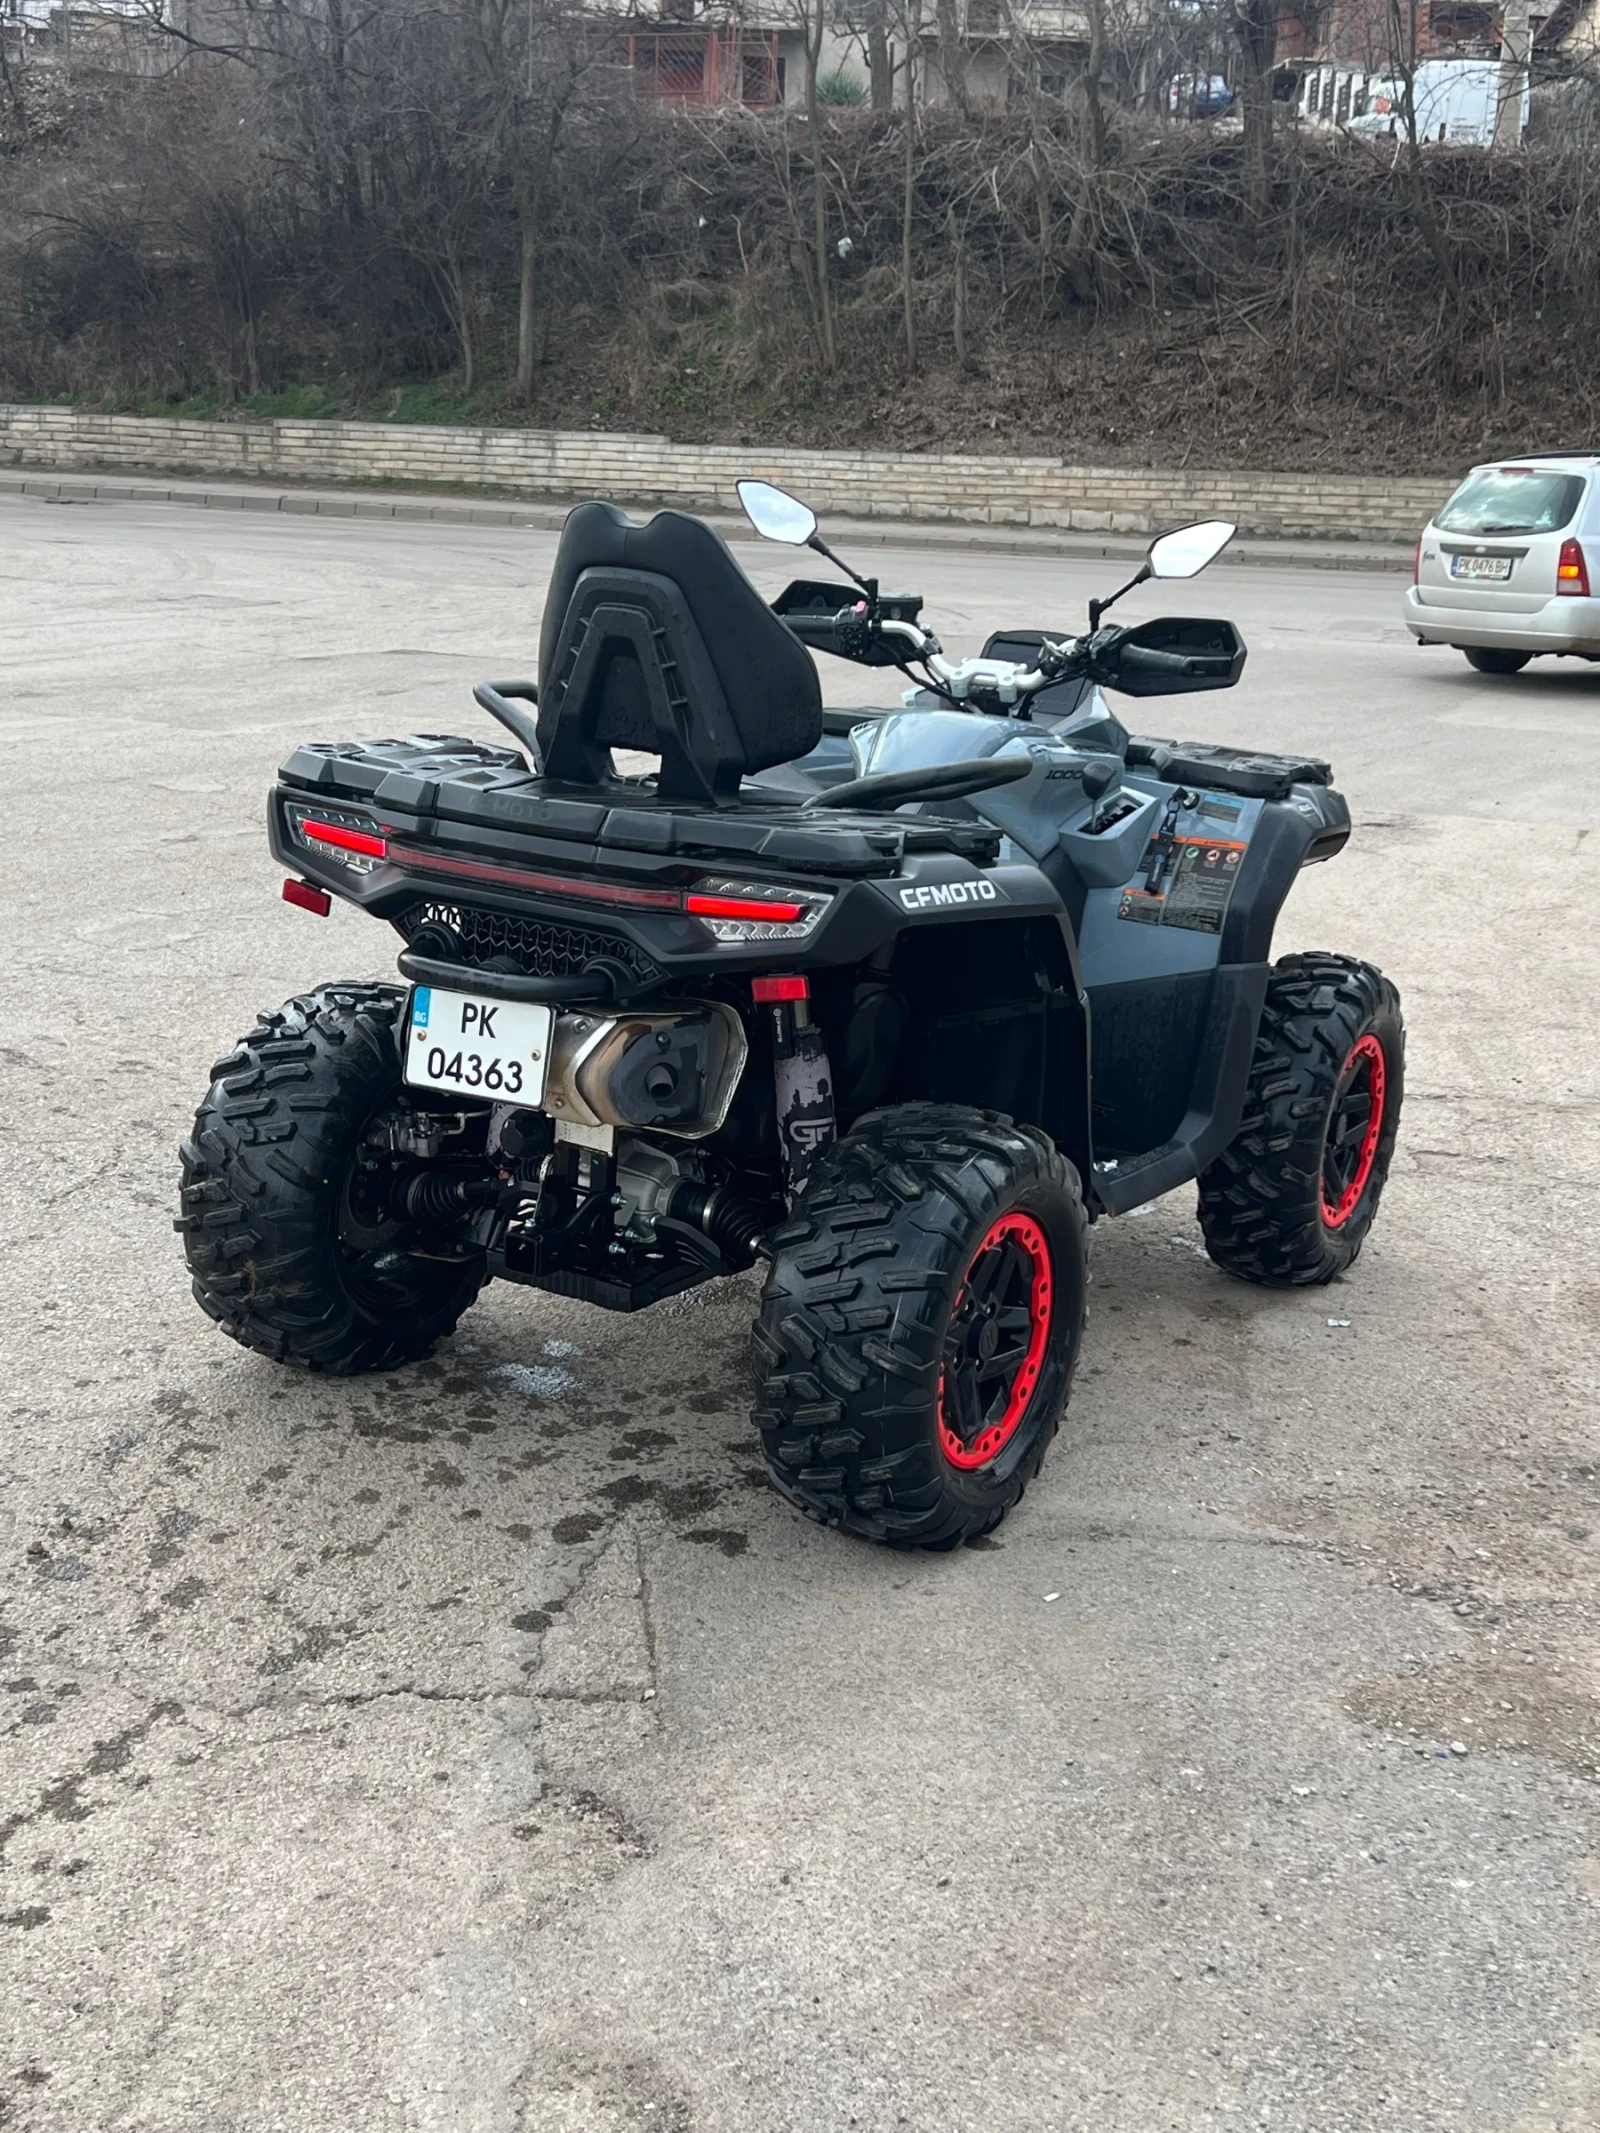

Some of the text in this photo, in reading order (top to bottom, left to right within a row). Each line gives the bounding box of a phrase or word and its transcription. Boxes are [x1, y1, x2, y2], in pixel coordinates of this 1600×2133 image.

[1045, 769, 1083, 780] 1000
[899, 880, 996, 909] CFMOTO
[414, 1011, 427, 1023] BG
[461, 1002, 499, 1039] PK
[427, 1047, 523, 1094] 04363
